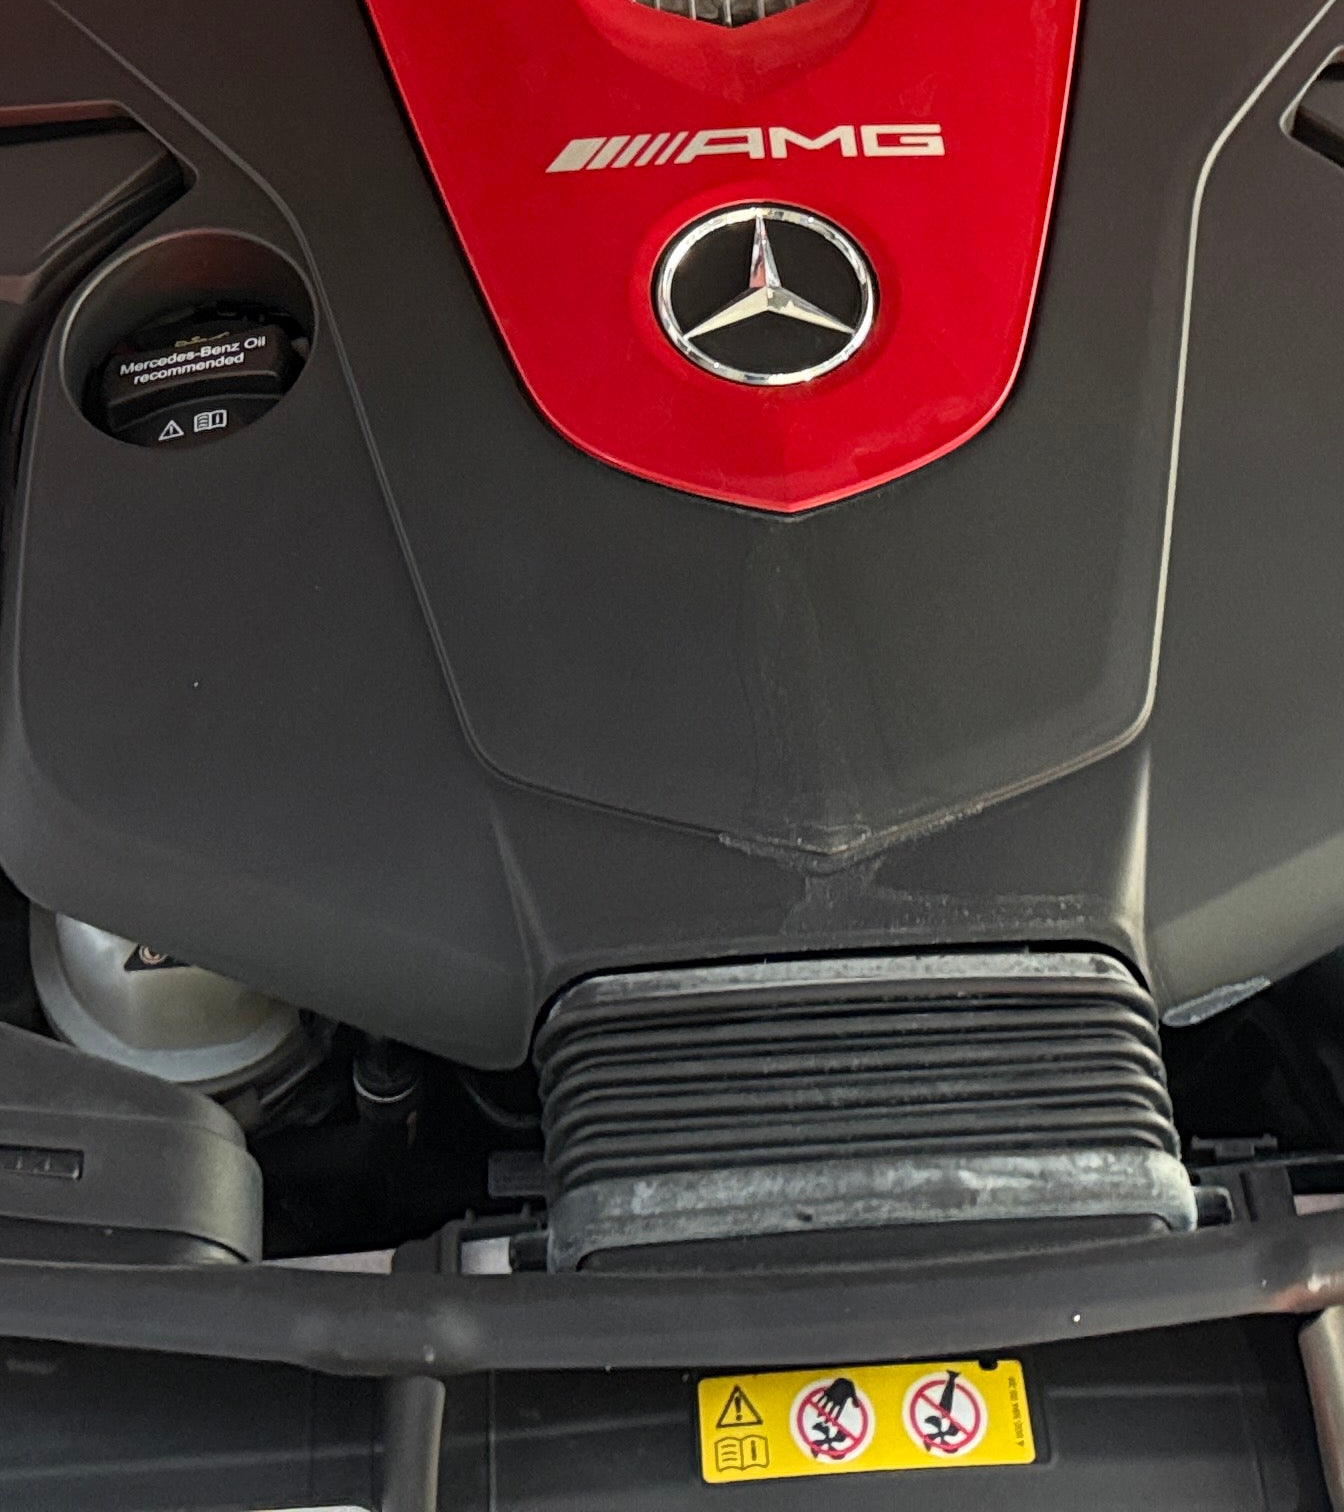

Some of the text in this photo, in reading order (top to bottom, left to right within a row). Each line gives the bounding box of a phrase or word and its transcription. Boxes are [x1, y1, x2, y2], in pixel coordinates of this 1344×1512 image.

[674, 124, 945, 165] AMG
[119, 336, 266, 376] Mercedes-Benz Oil
[133, 352, 245, 385] recommended
